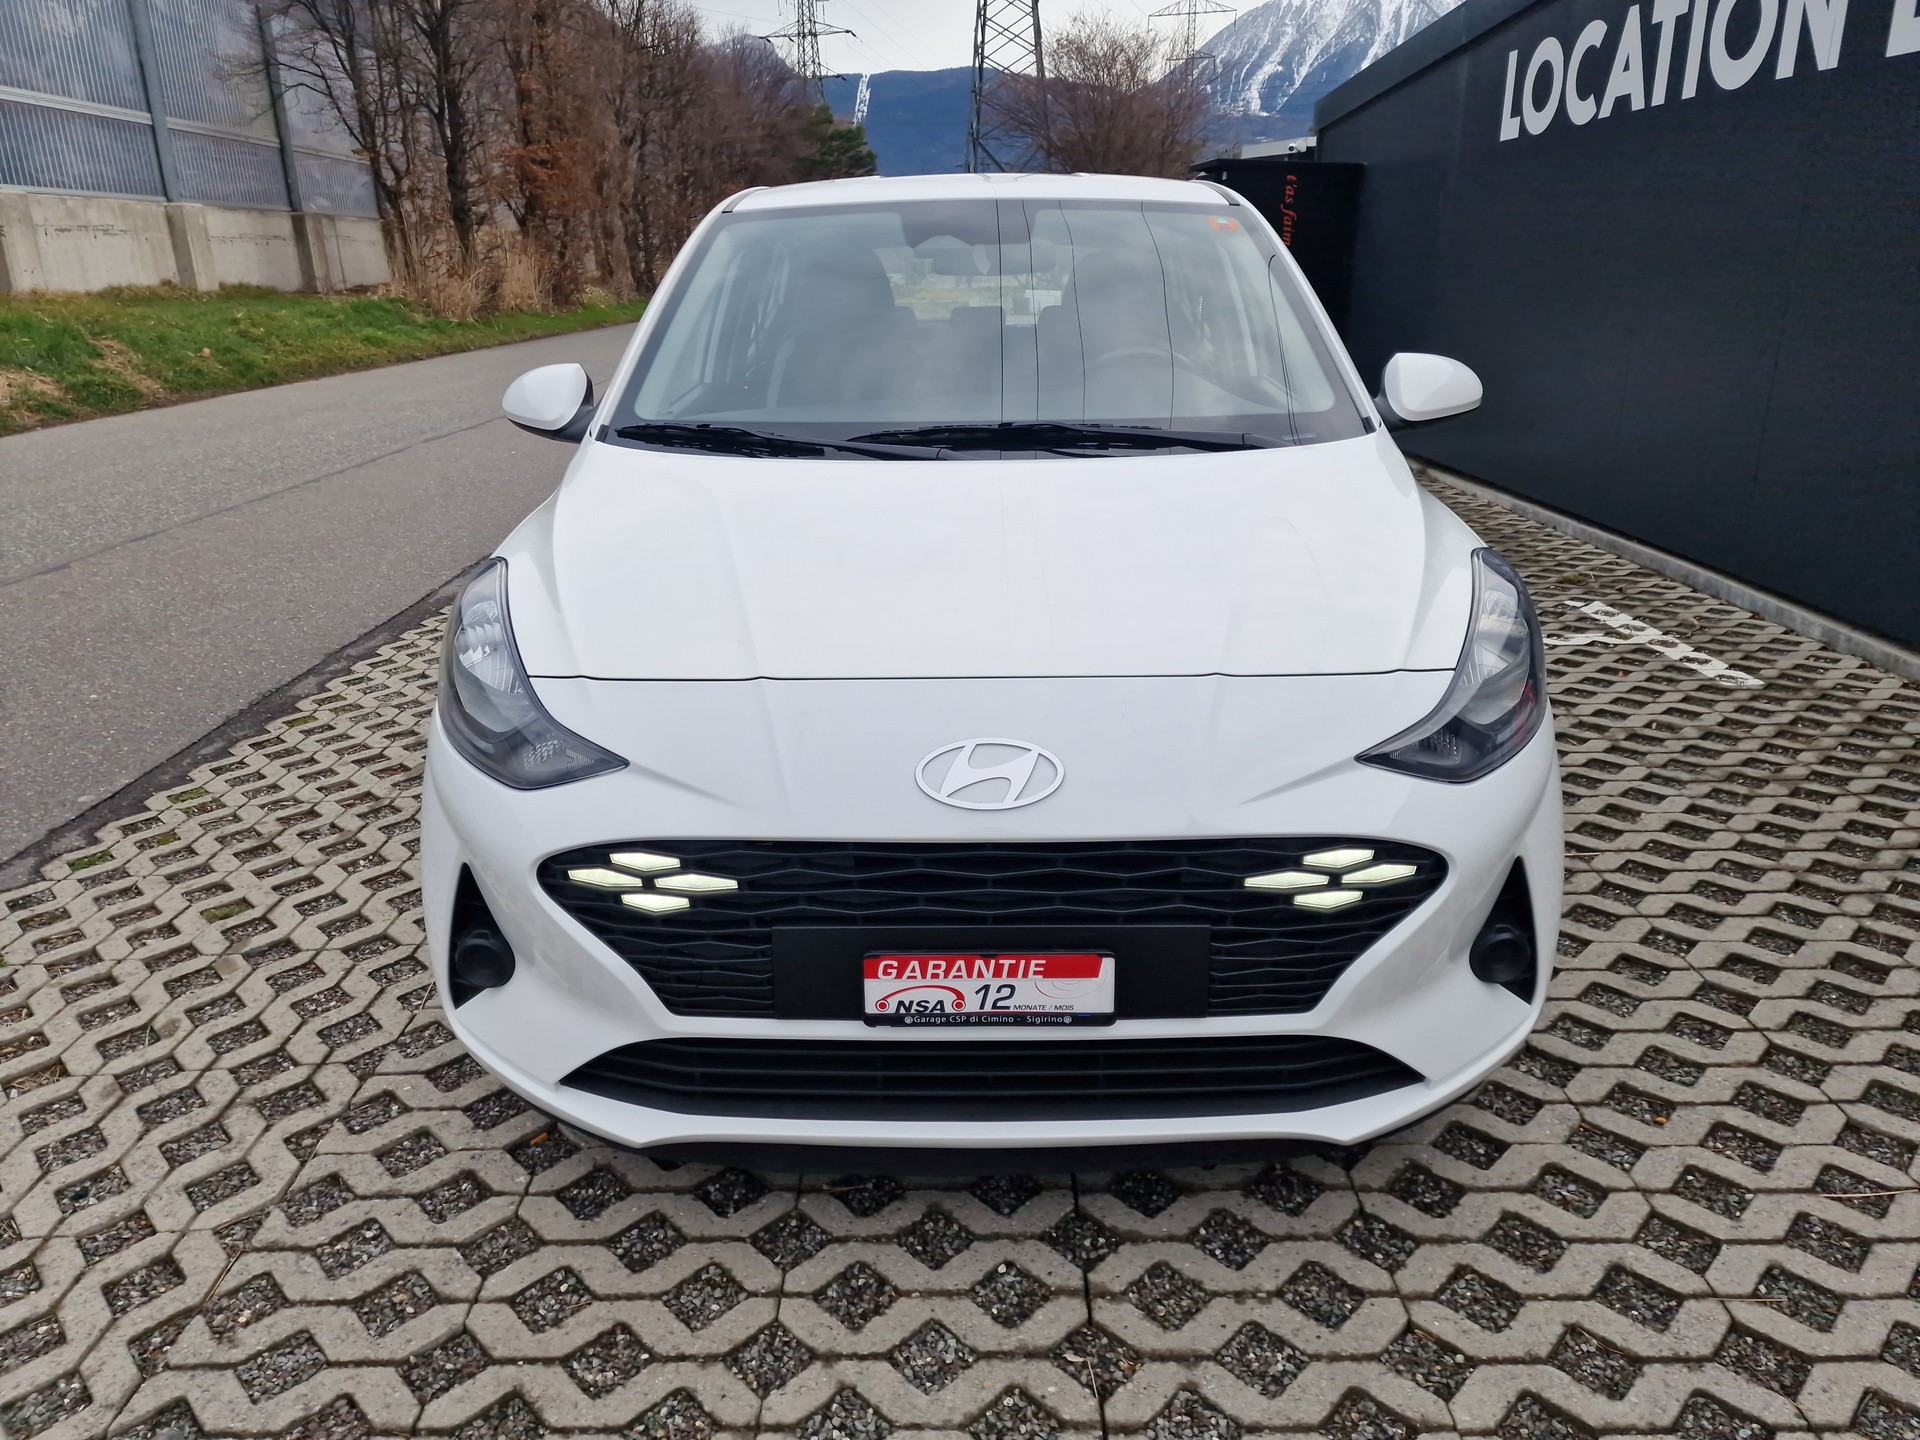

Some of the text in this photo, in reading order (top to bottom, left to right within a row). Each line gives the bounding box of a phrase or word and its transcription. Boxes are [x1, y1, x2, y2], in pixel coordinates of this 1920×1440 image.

[1500, 0, 1848, 142] LOCATION
[877, 959, 1047, 980] GARANTIE
[894, 999, 946, 1013] NSA
[974, 983, 1016, 1011] 12
[913, 1015, 947, 1024] Garage
[949, 1015, 967, 1023] CSP
[969, 1015, 979, 1023] di
[981, 1015, 1014, 1023] Cimino
[1026, 1015, 1063, 1025] Sigirino
